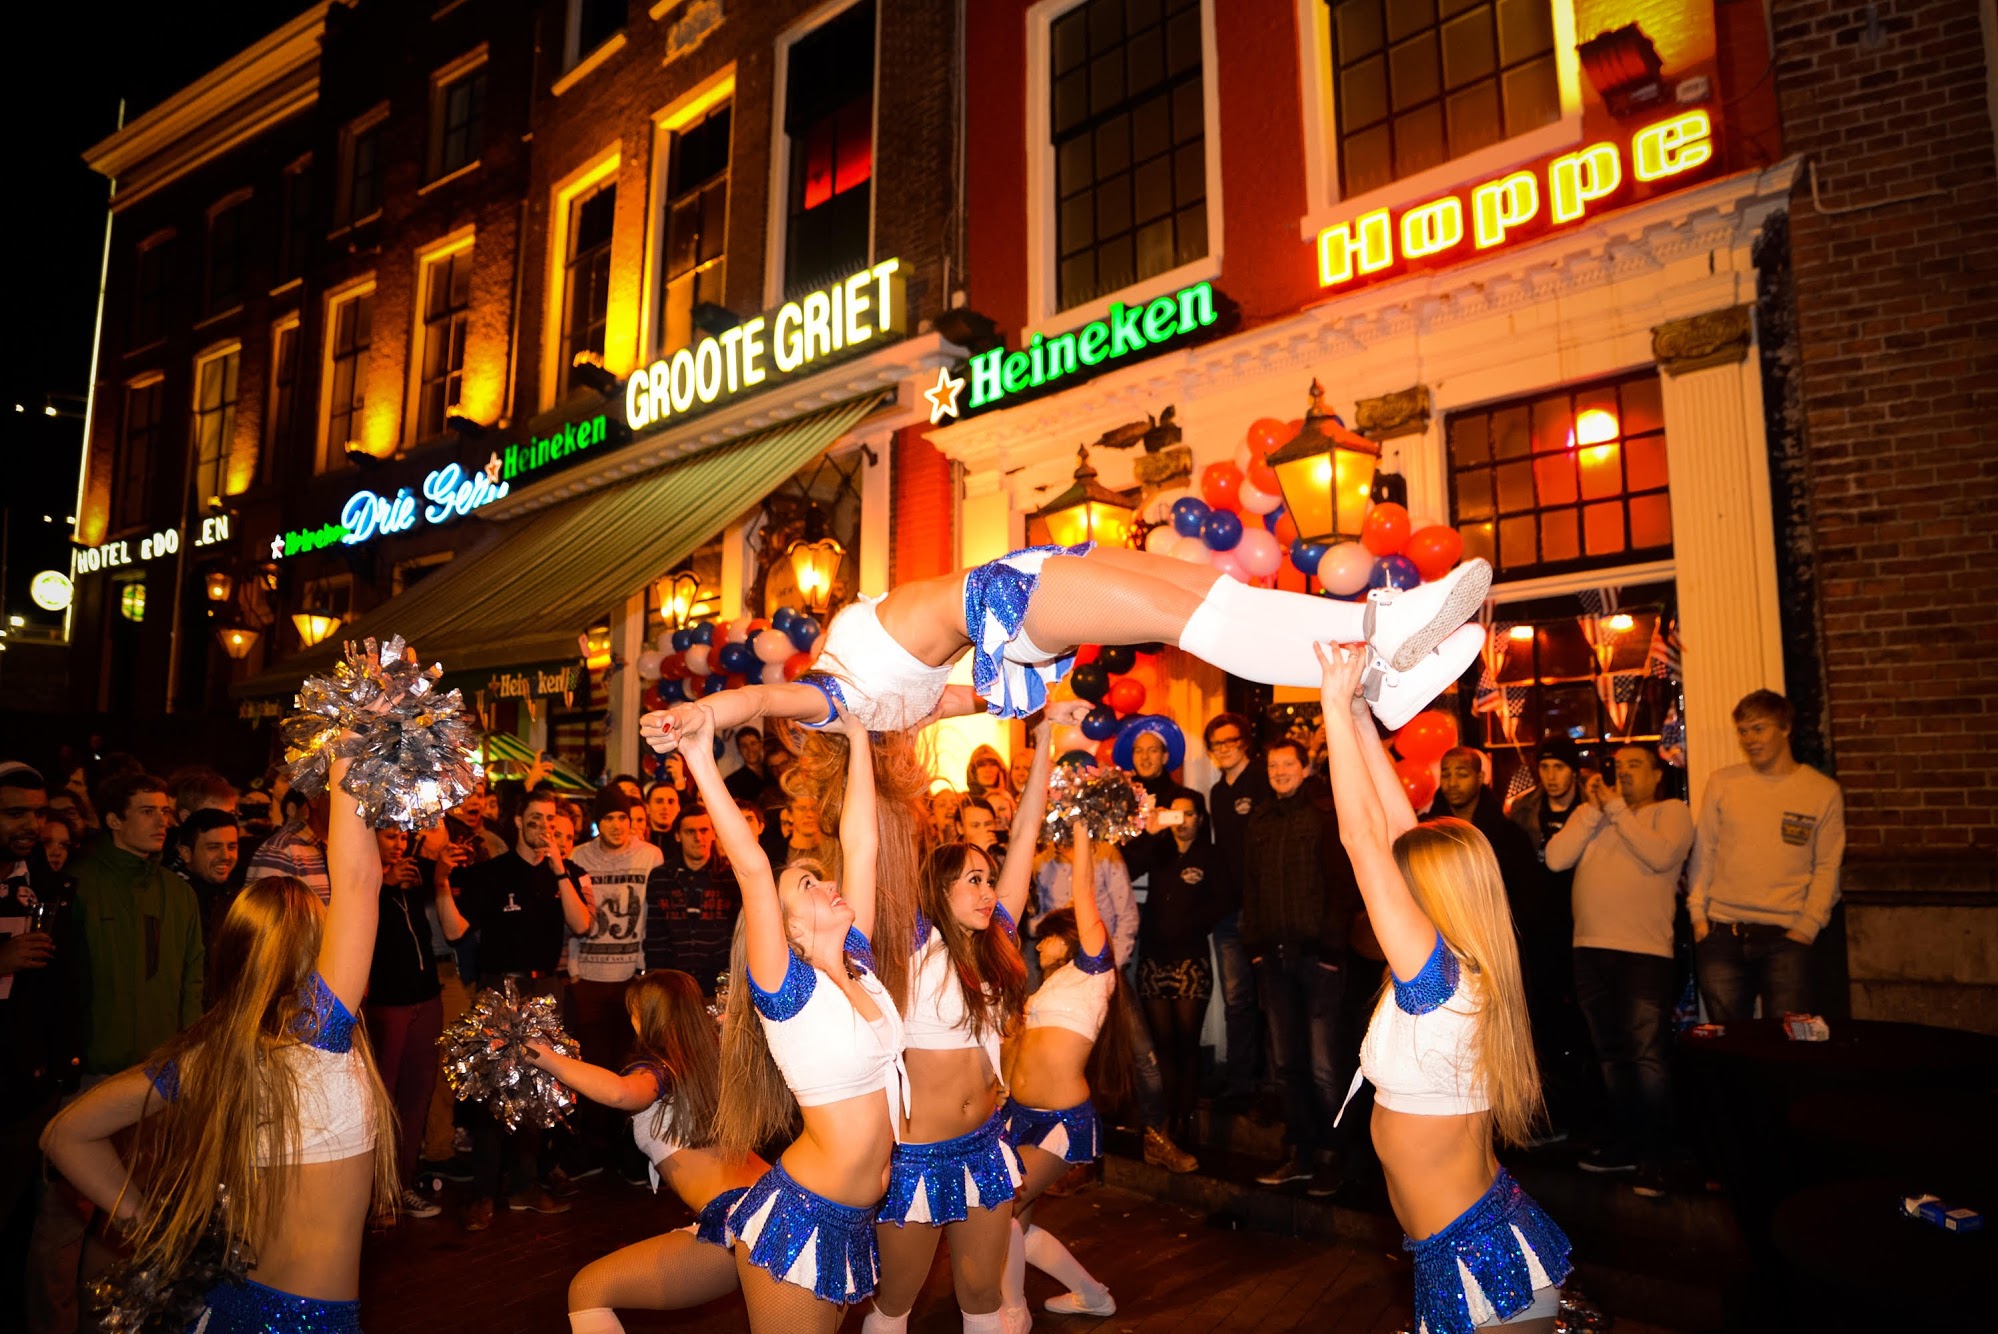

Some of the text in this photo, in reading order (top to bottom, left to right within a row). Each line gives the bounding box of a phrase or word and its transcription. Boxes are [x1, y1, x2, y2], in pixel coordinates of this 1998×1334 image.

[1317, 108, 1713, 288] Hoppe
[625, 256, 900, 432] GROOTE GRIET
[968, 281, 1218, 408] Heineken
[503, 414, 606, 480] Heineken
[77, 540, 132, 574] HOTEL
[341, 489, 416, 545] Drie
